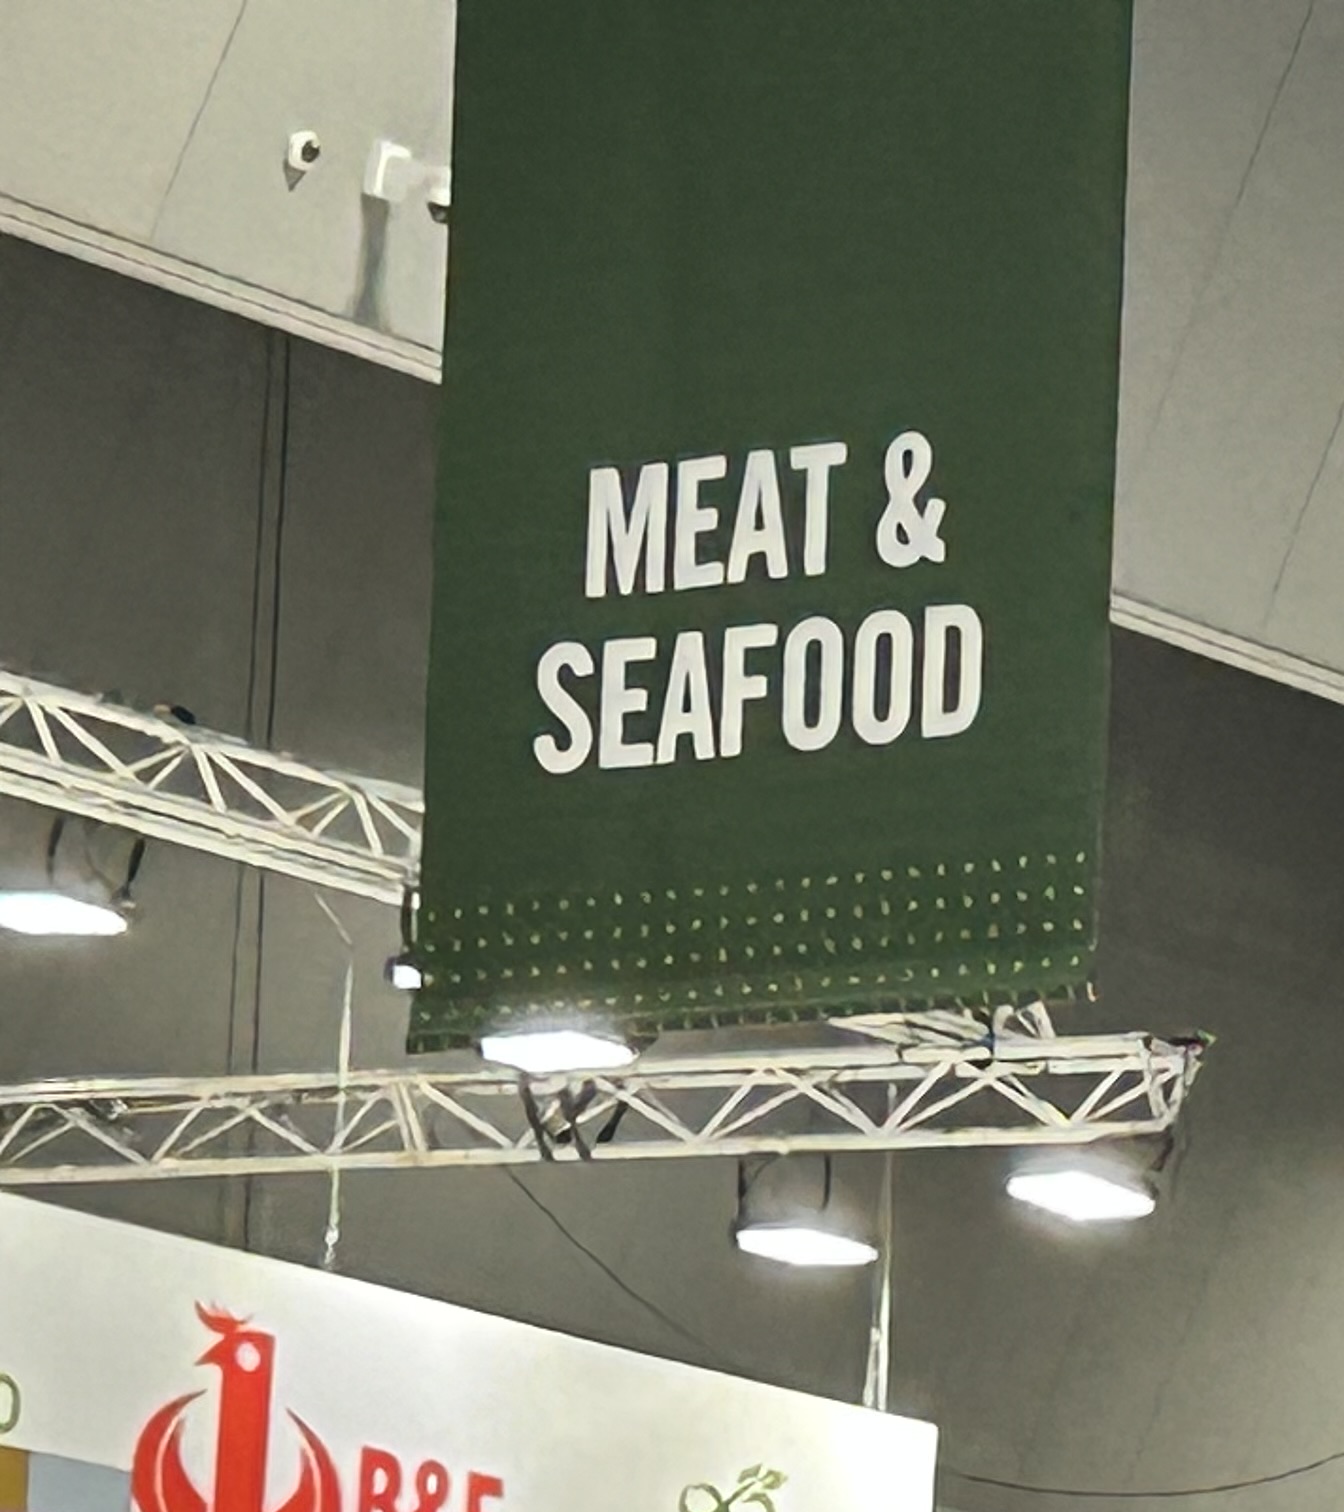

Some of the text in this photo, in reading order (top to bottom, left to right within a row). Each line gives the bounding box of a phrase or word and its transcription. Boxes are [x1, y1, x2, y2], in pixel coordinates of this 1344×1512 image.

[585, 430, 946, 598] MEAT &
[533, 603, 984, 775] SEAFOOD
